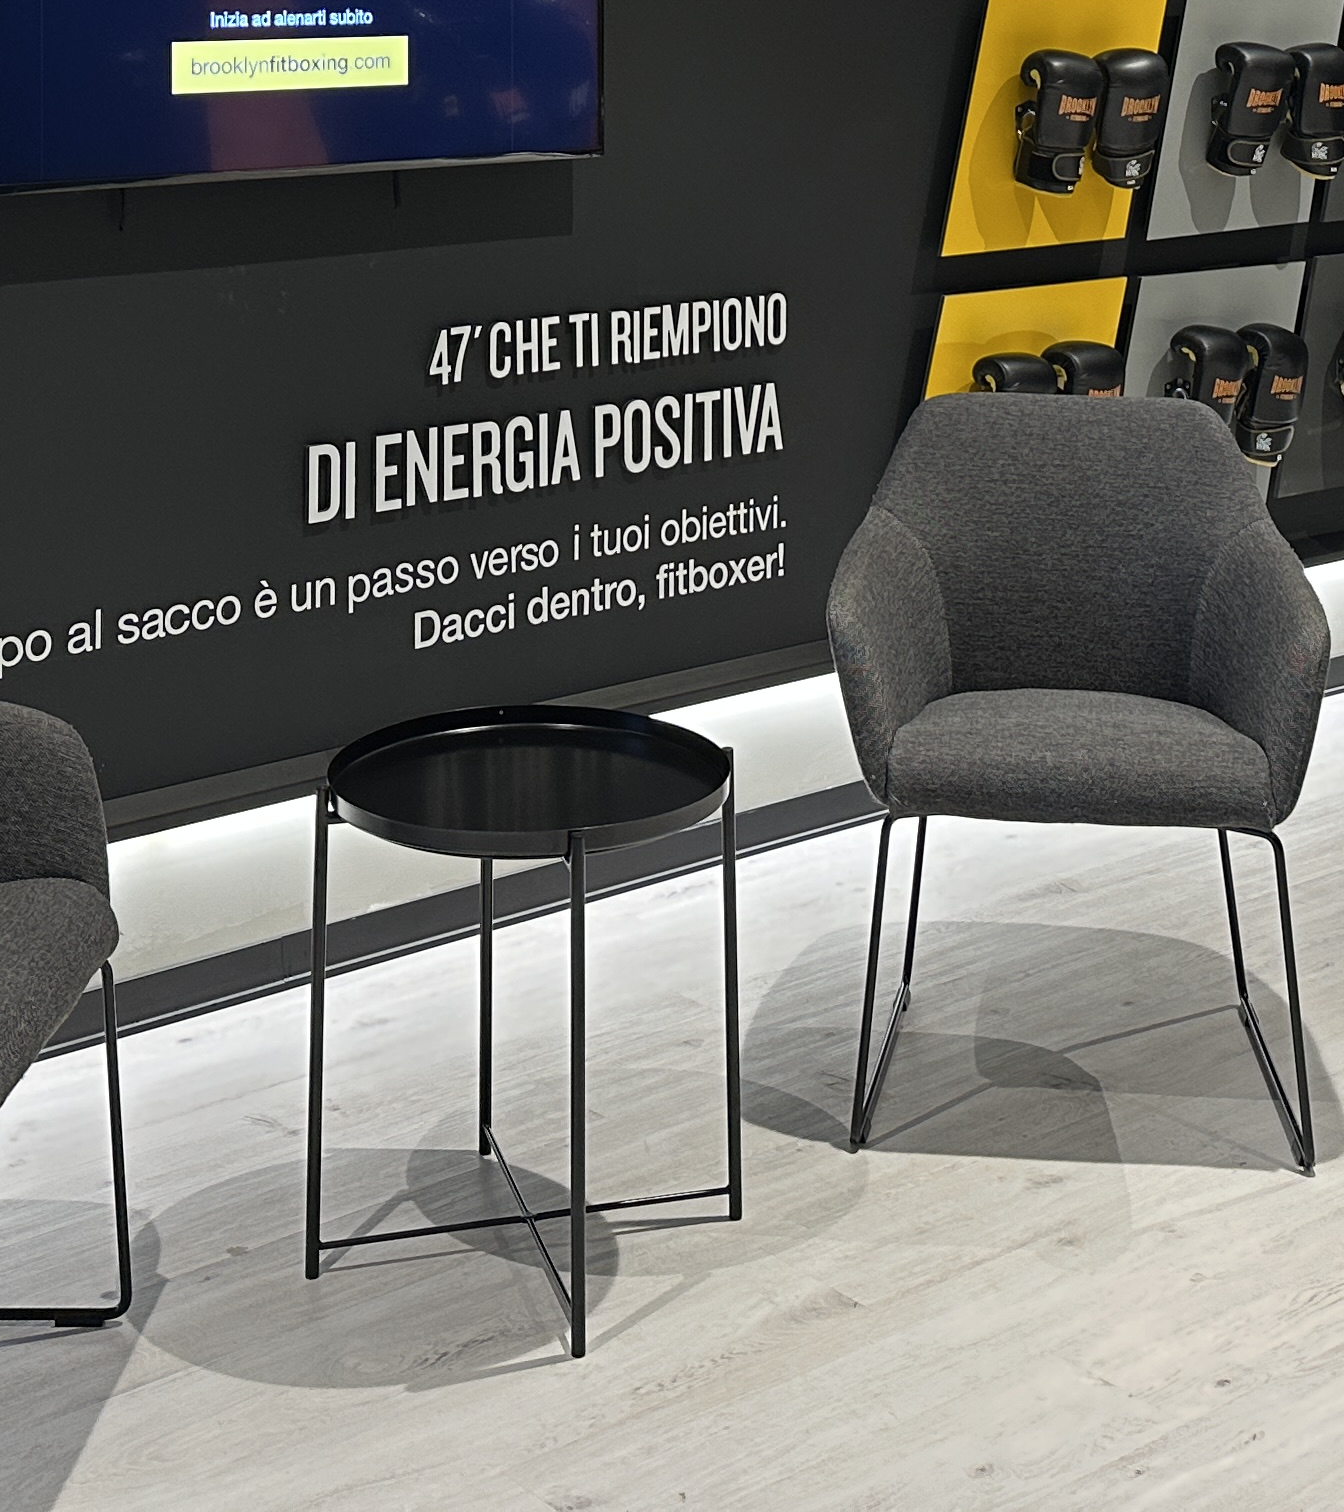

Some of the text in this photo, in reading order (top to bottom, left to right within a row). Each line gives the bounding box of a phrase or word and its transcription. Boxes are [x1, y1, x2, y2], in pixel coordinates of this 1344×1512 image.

[251, 10, 271, 27] ad
[329, 7, 373, 26] subito
[192, 54, 390, 78] brooklynfitboxing.com
[490, 316, 560, 378] CHE
[569, 313, 599, 367] TI
[611, 293, 786, 364] RIEMPIONO
[308, 383, 783, 524] DI ENERGIA POSITIVA
[68, 609, 101, 654] al
[118, 596, 241, 644] sacco
[255, 580, 277, 618] è
[292, 578, 335, 612] un
[349, 556, 458, 613] passo
[470, 540, 559, 579] verso
[573, 523, 581, 561] i
[590, 514, 649, 557] tuoi
[661, 495, 786, 546] obiettivi.
[415, 543, 784, 649] Dacci dentro, fitboxer!
